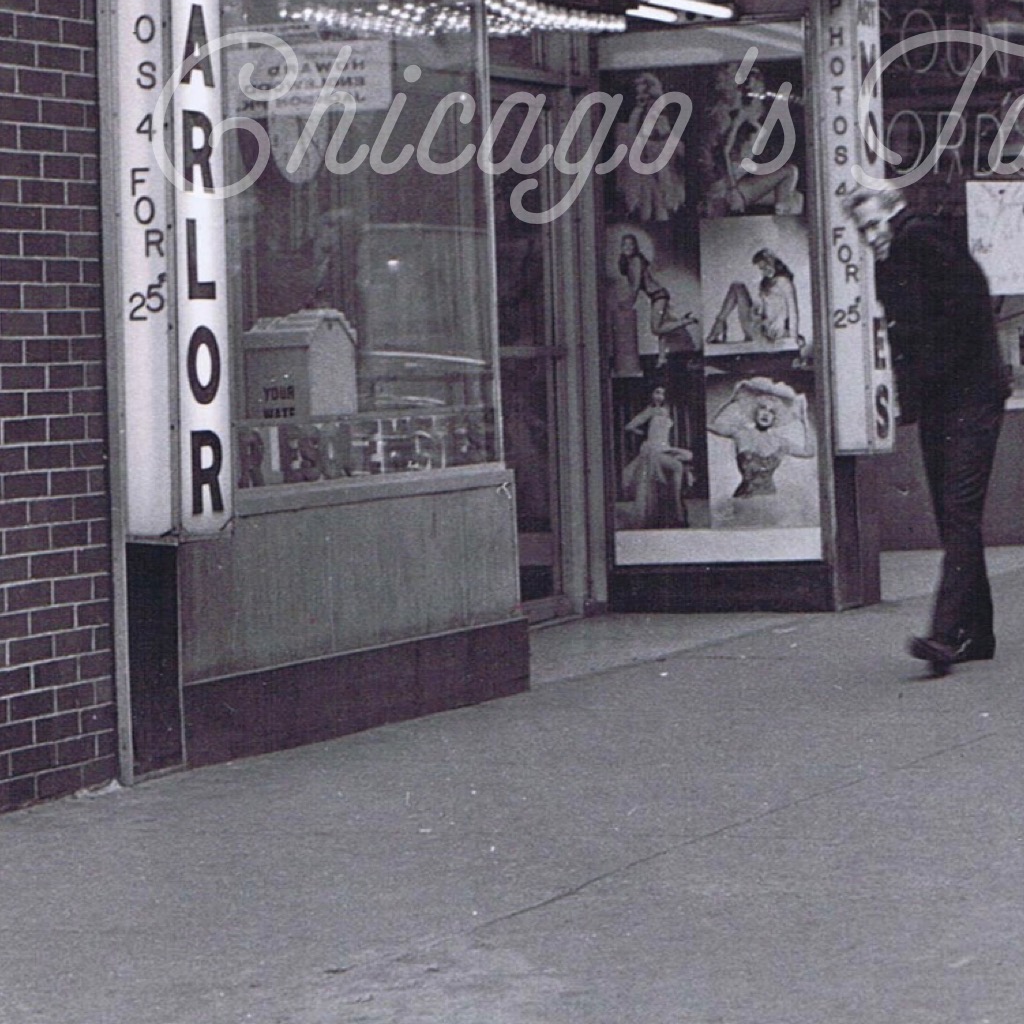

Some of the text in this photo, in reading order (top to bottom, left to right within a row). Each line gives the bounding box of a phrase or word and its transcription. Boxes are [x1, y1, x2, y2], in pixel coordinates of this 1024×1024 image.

[135, 112, 158, 142] 4
[130, 168, 166, 259] FOR
[859, 40, 891, 440] MOES
[833, 227, 859, 284] FOR
[263, 385, 295, 401] YOUR
